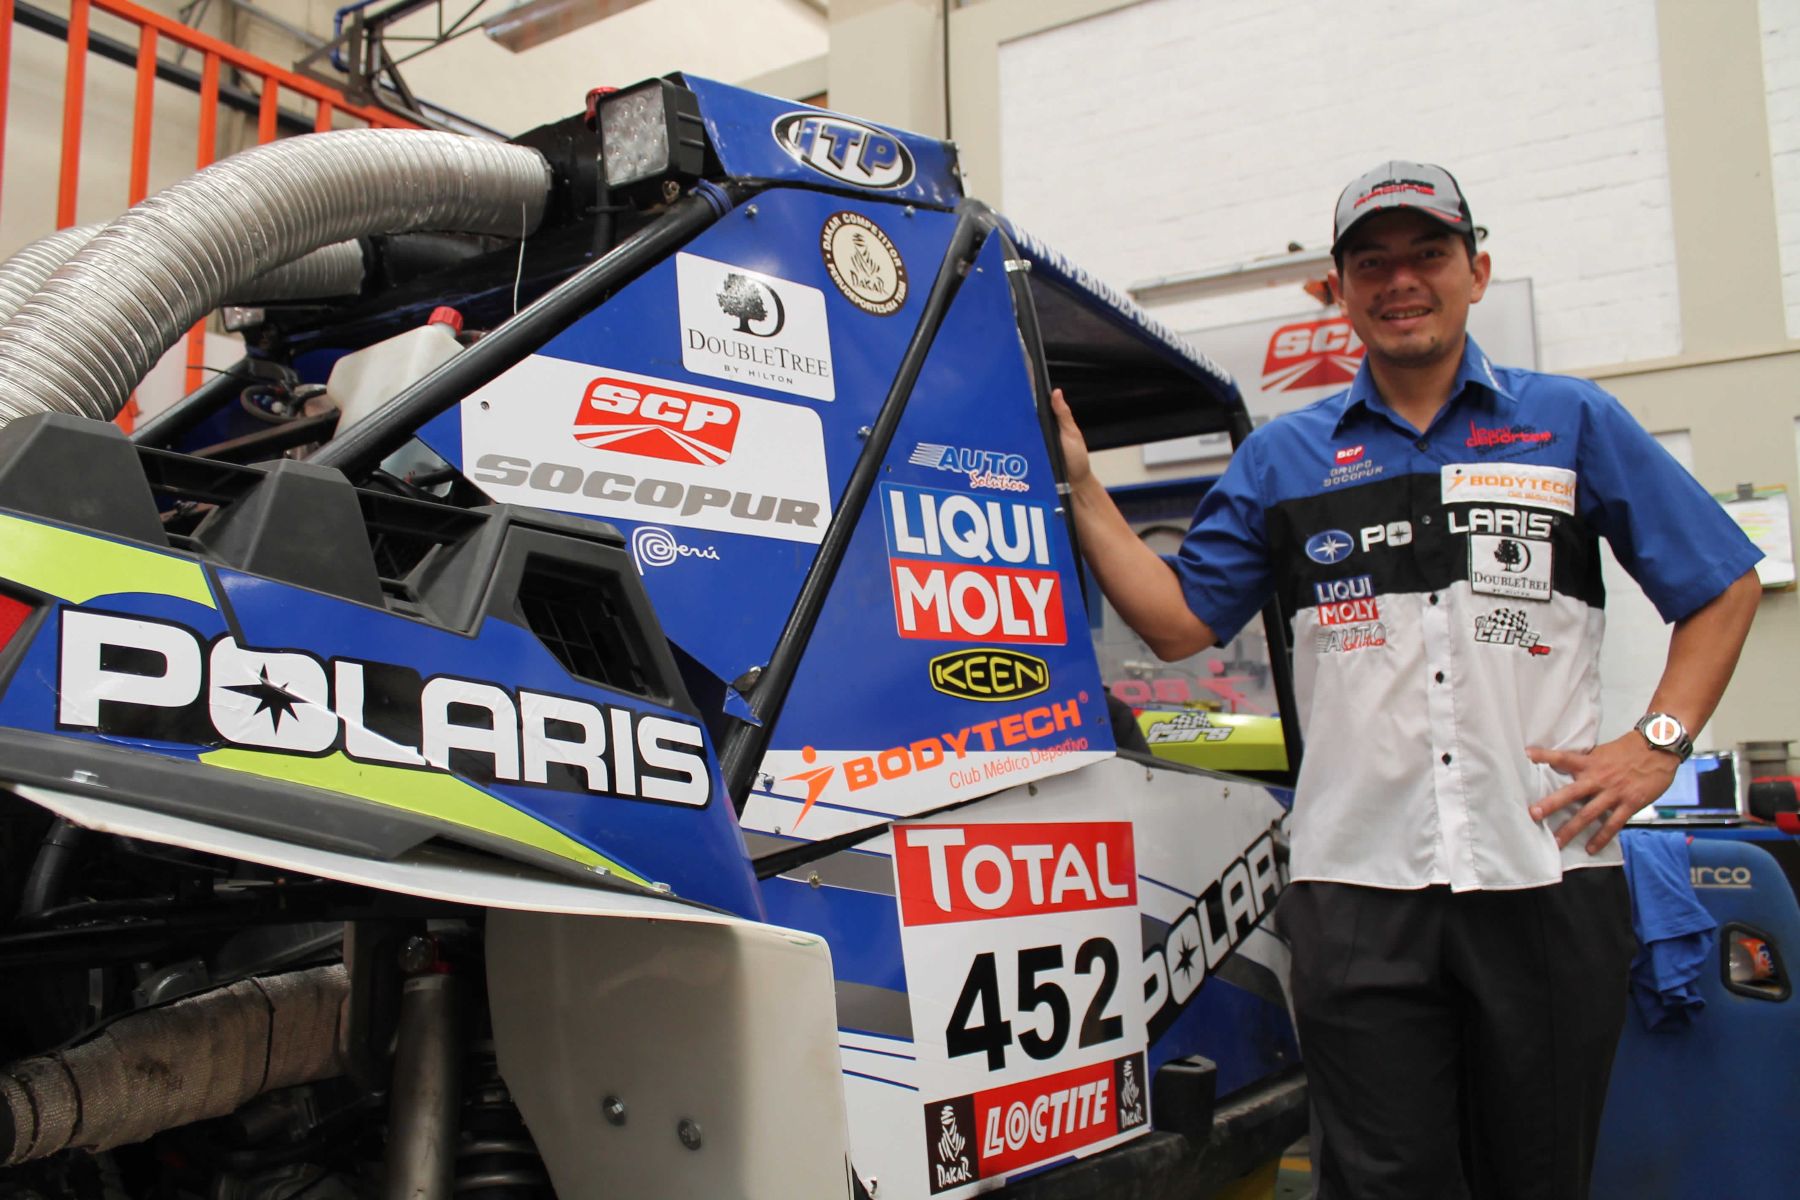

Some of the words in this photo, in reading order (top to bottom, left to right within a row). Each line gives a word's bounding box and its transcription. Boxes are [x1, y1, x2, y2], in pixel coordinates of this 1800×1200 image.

[822, 216, 841, 251] DAKAR
[842, 213, 902, 267] COMPETITOR
[850, 270, 888, 295] DAKAR
[688, 328, 829, 377] DOUBLETREE
[724, 364, 739, 372] BY
[749, 371, 793, 384] HILTON
[590, 383, 733, 431] SCP
[938, 446, 1028, 480] AUTO
[1323, 466, 1383, 487] SOCOPUR
[1330, 459, 1373, 477] GRUPO
[474, 453, 821, 528] SOCOPUR
[969, 470, 1030, 492] Solution
[1470, 475, 1575, 496] BODYTECH
[889, 490, 1050, 565] LIQUI
[1448, 508, 1553, 538] LARIS
[1317, 577, 1372, 603] LIQUI
[1474, 572, 1549, 591] DOUBLETREE
[896, 566, 1055, 637] MOLY
[1321, 600, 1375, 625] MOLY
[936, 656, 1044, 693] KEEN
[59, 609, 709, 806] POLARIS
[949, 768, 981, 789] Club
[983, 757, 1029, 779] Médico
[1029, 737, 1089, 766] Deportivo
[906, 828, 1129, 912] TOTAL
[1142, 834, 1291, 1024] POLAR
[945, 936, 1124, 1072] 452
[982, 1077, 1110, 1159] LOCTITE
[1120, 1103, 1143, 1129] DAKAR
[936, 1156, 972, 1189] DAKAR
